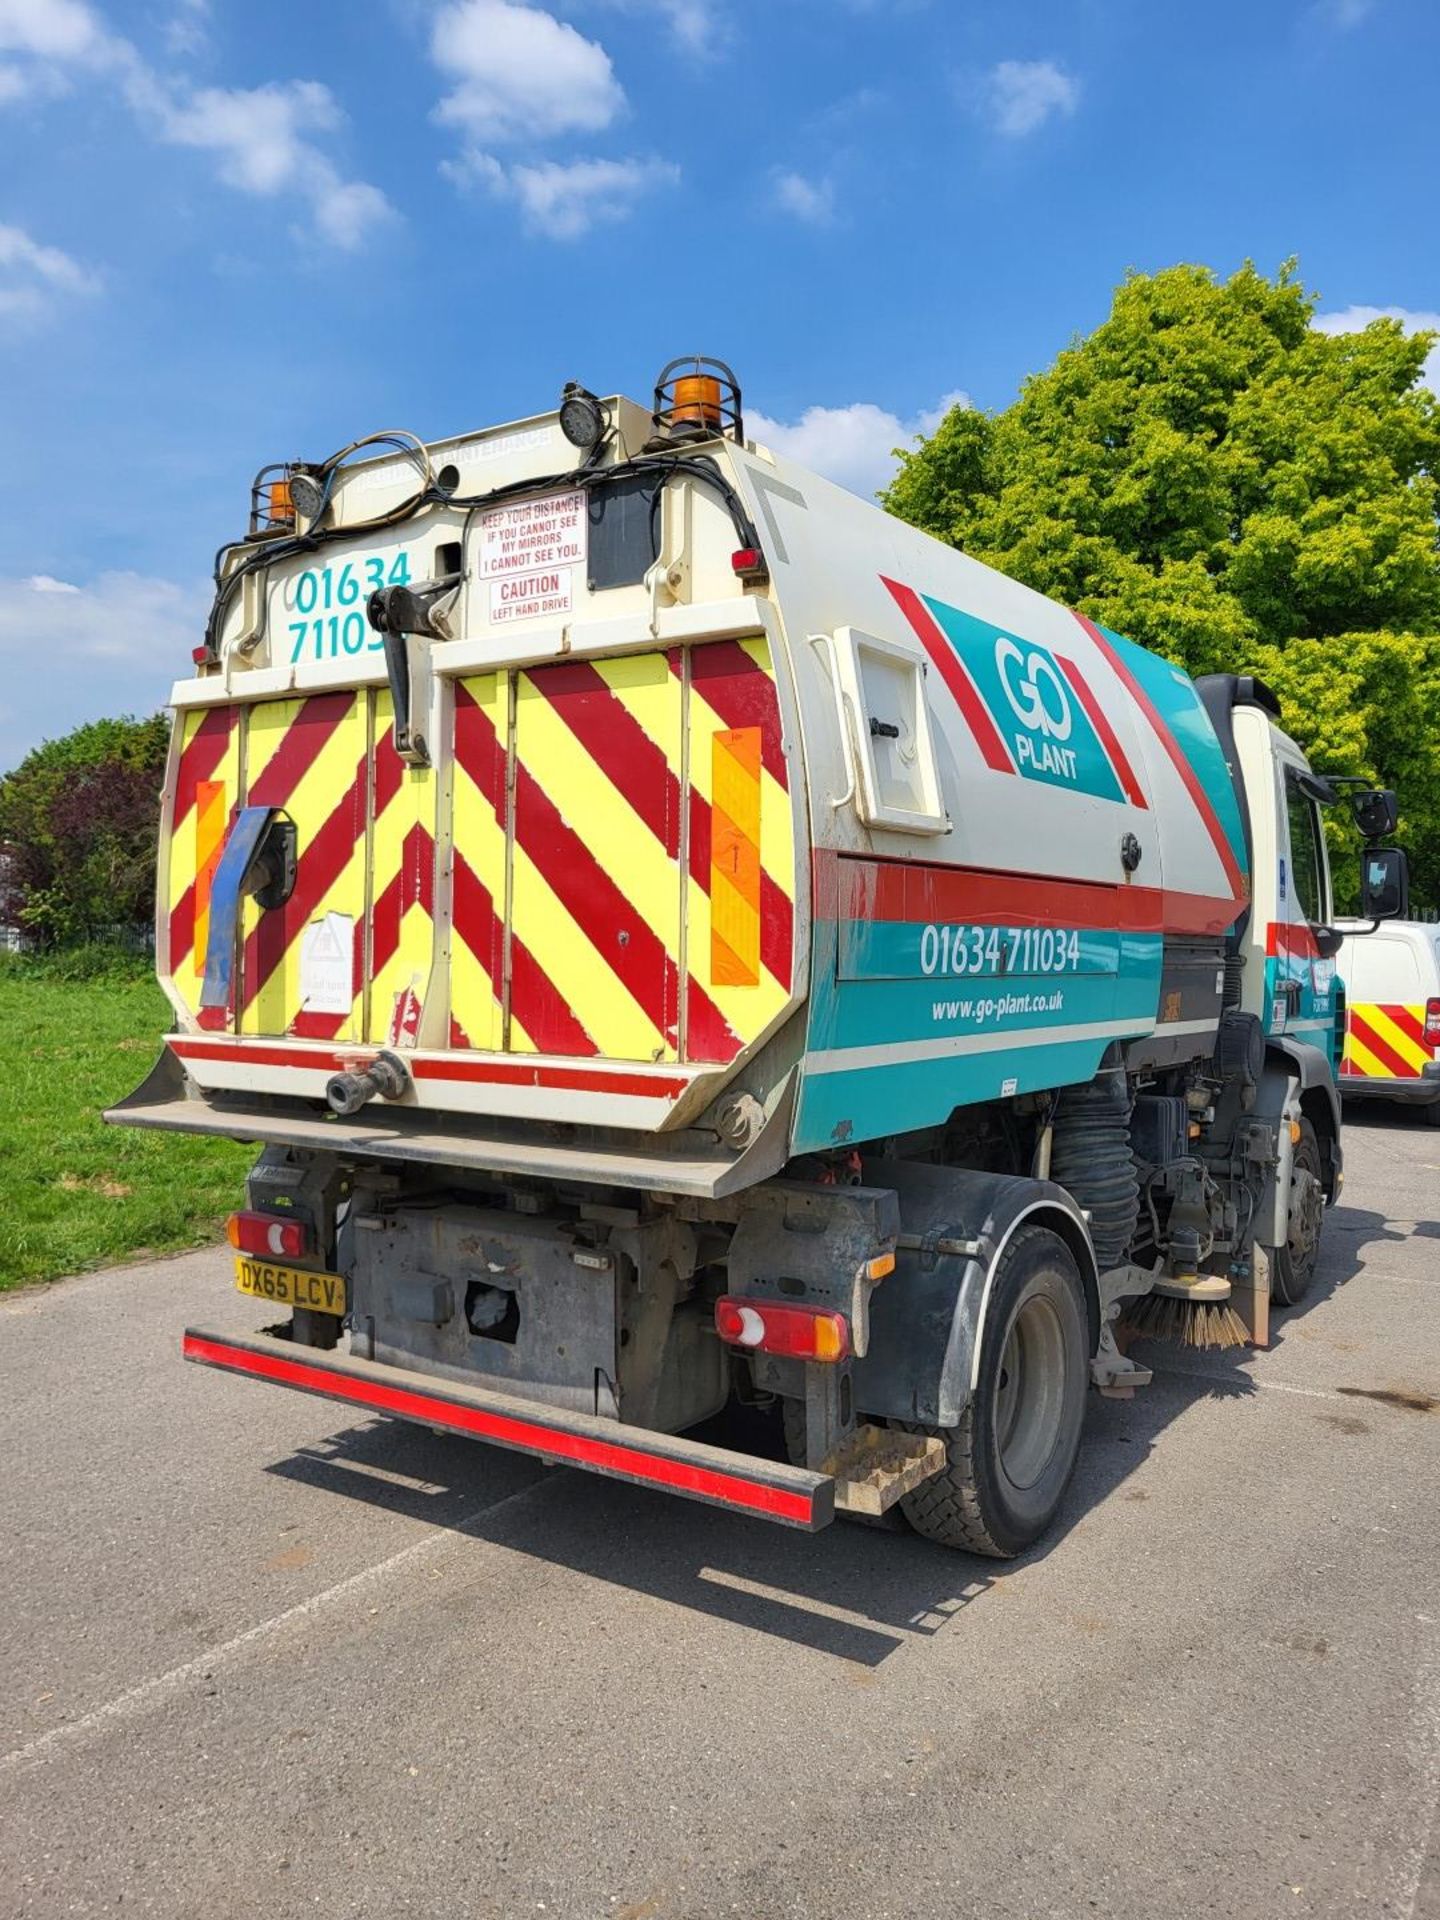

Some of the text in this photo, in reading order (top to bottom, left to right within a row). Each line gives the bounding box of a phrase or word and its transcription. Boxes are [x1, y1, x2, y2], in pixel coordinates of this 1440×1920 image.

[482, 512, 504, 529] KEEP
[507, 506, 532, 525] YOUR
[488, 515, 578, 543] IF YOU CANNOT SEE
[491, 554, 531, 571] CANNOT
[534, 548, 553, 563] SEE
[556, 544, 582, 559] YOU.
[502, 532, 562, 553] MY MIRRORS
[296, 552, 411, 614] 01634
[500, 573, 560, 600] CAUTION
[493, 597, 569, 620] LEFT HAND DRIVE
[994, 637, 1072, 741] GO
[1014, 733, 1076, 780] PLANT
[920, 924, 1080, 975] 01634 711034
[932, 990, 1064, 1023] www.go-plant.co.uk
[241, 1262, 335, 1308] DX65 LCV
